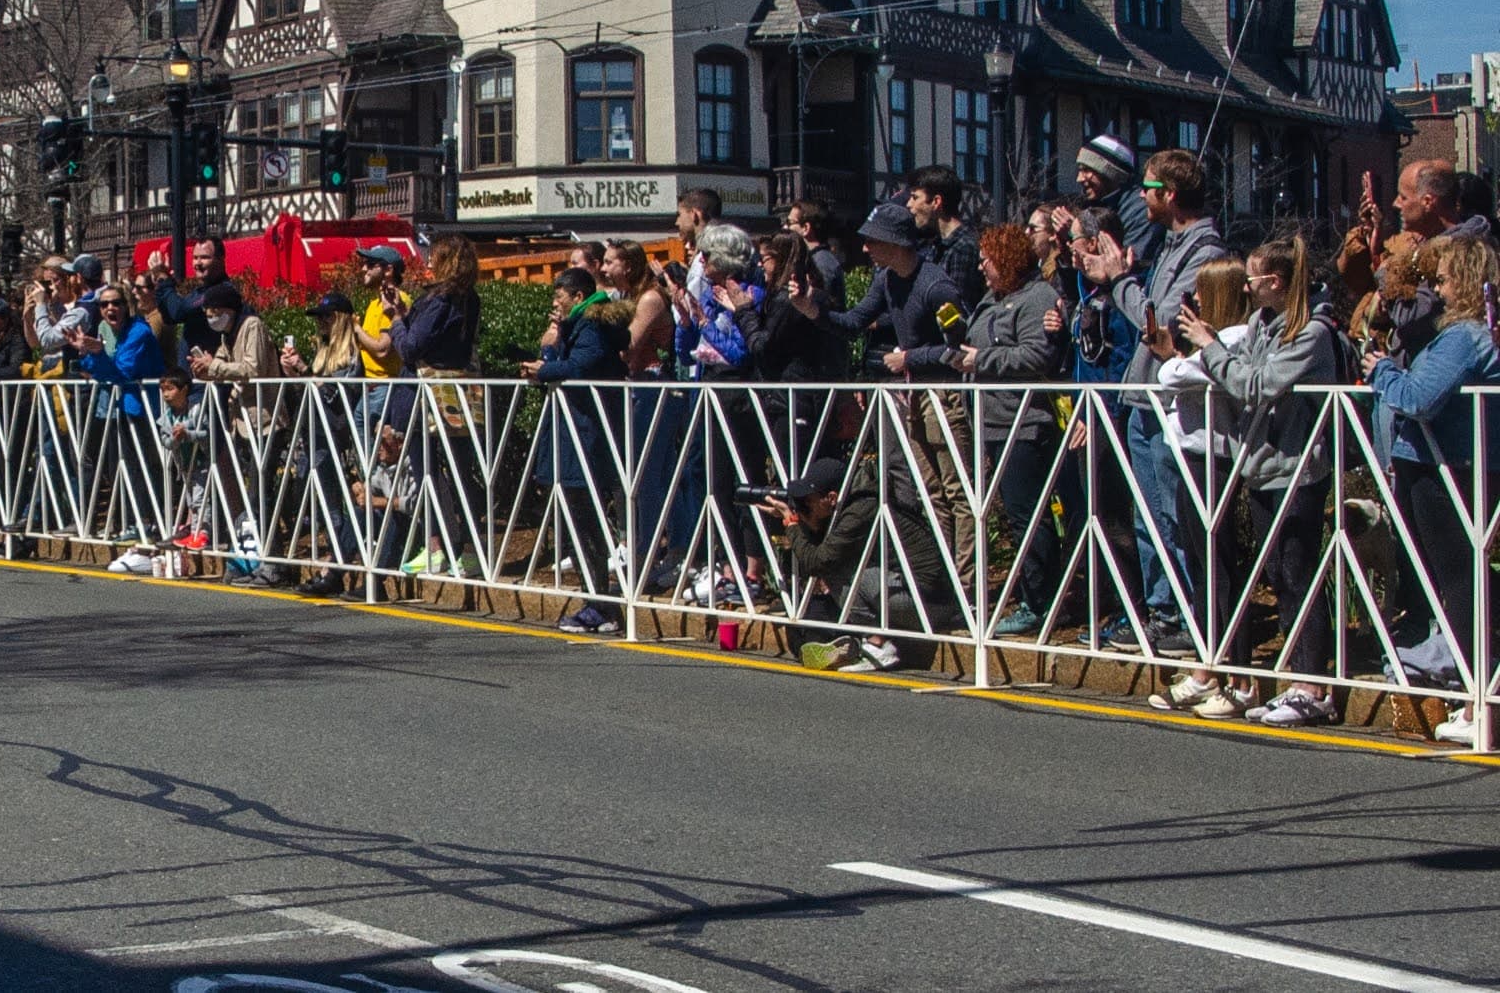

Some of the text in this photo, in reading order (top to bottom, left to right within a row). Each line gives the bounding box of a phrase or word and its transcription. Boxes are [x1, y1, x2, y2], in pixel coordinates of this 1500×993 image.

[595, 180, 660, 195] PIERCE
[457, 187, 533, 209] rooklineBank
[563, 190, 652, 209] BUILDING
